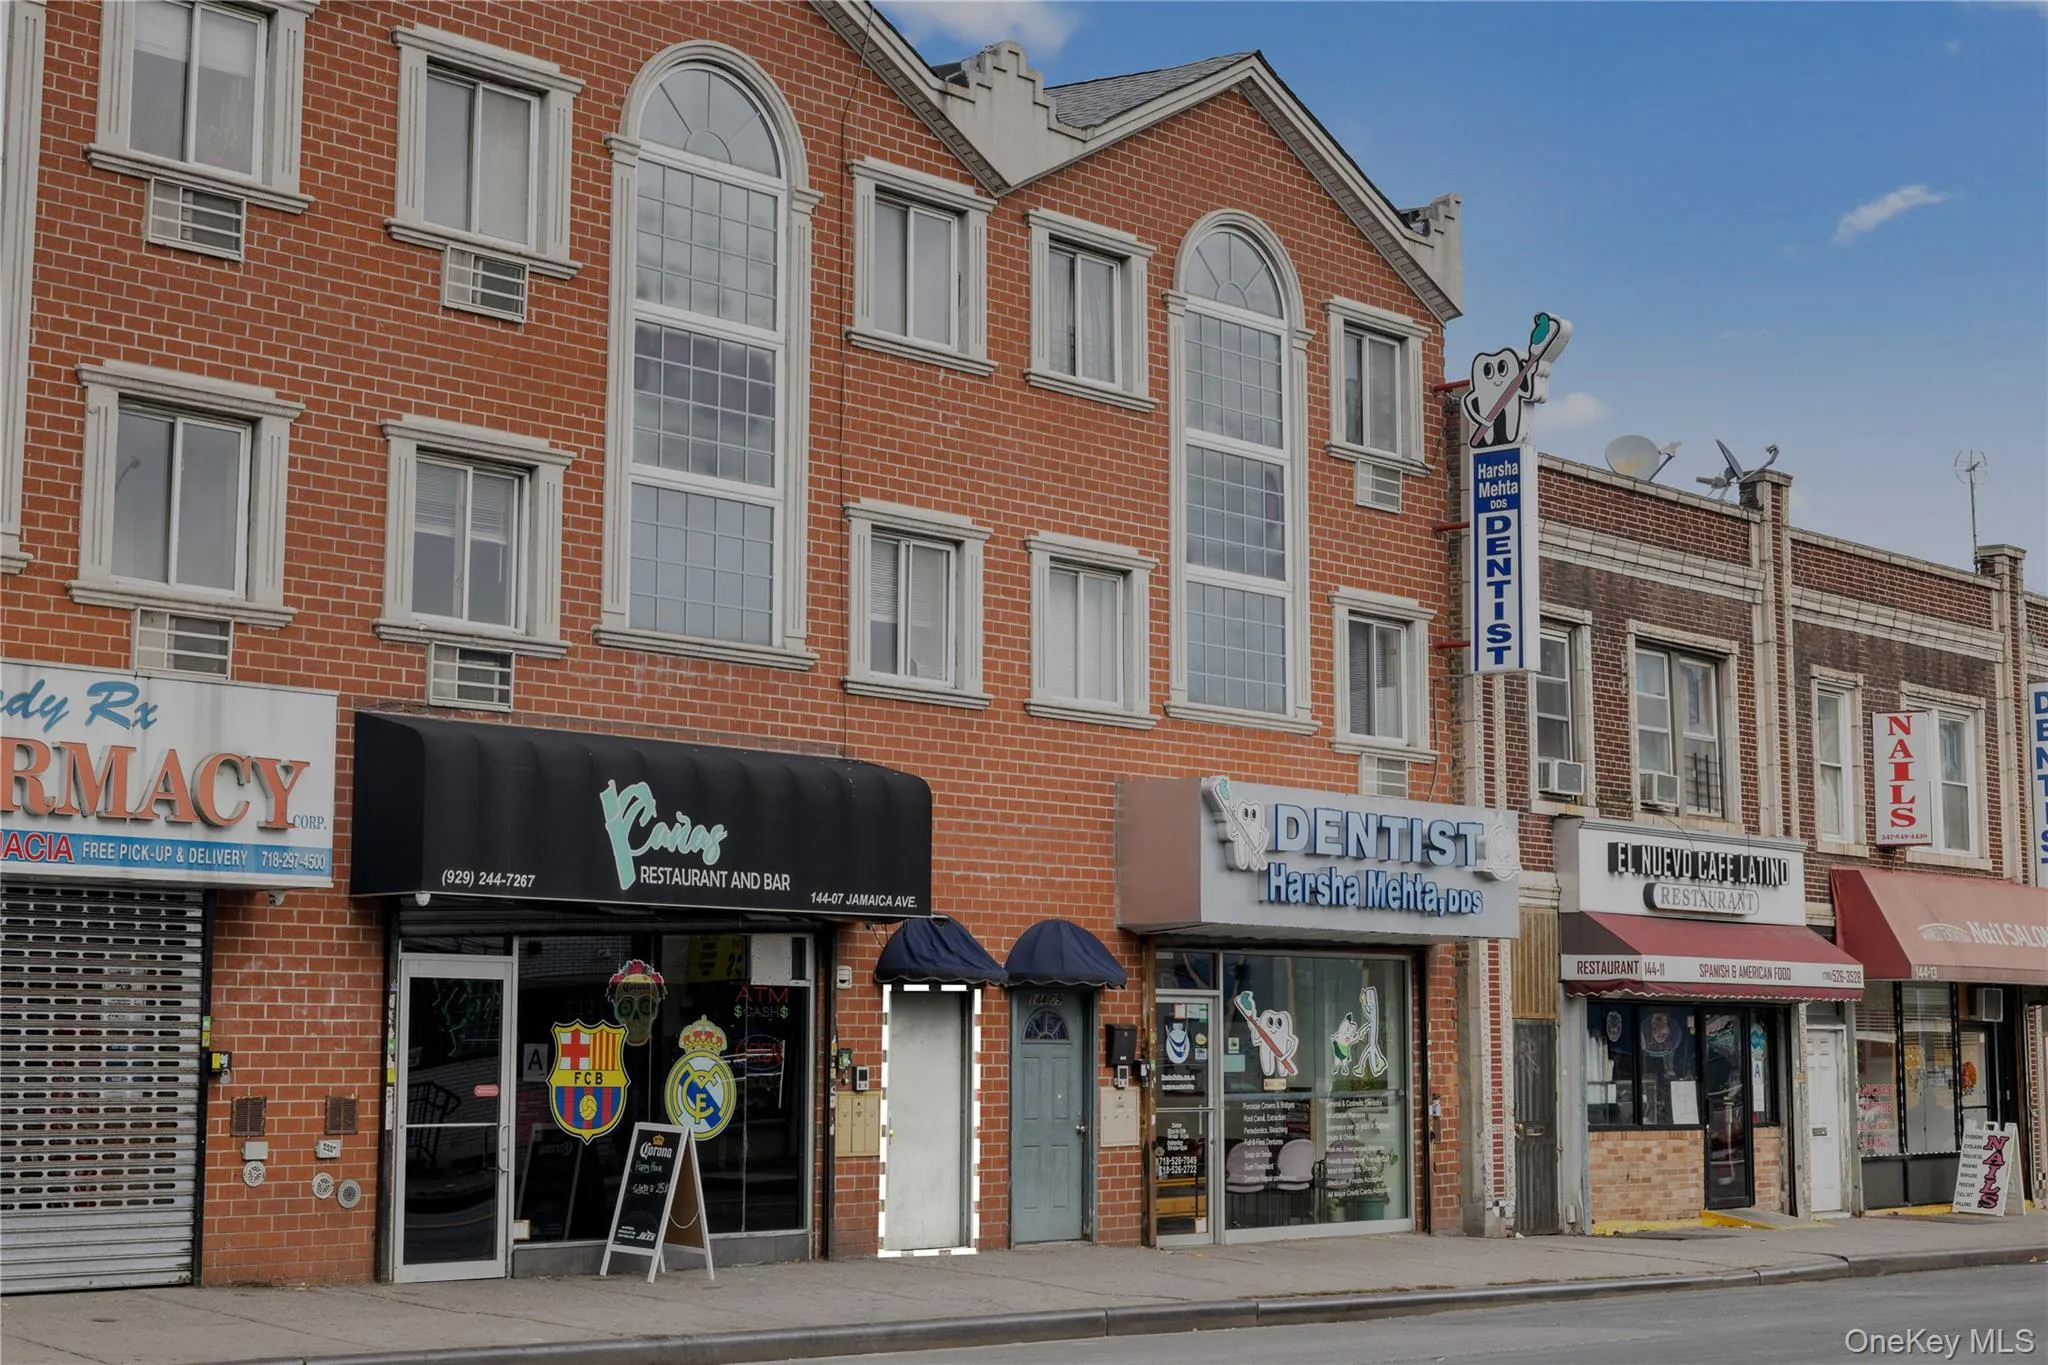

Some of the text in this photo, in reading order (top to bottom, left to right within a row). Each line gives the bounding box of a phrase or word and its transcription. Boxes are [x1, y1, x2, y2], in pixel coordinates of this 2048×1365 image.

[1478, 459, 1519, 479] Harsha
[1478, 481, 1519, 498] Mehta
[1490, 499, 1508, 509] DDS
[1486, 515, 1512, 665] DENTIST
[0, 679, 158, 733] dy Rx
[1887, 715, 1916, 827] NAILS
[293, 815, 327, 830] CORP.
[1274, 803, 1484, 867] DENTIST
[83, 841, 326, 871] FREE PICK-UP & DELIVERY 718-297-4500
[1617, 842, 1789, 886] EL NUEVO CAFE LATINO
[442, 869, 536, 888] (929) 244-7267
[640, 865, 791, 891] RESTAURANT AND BAR
[1268, 862, 1360, 907] Harsha
[1447, 887, 1484, 915] DDS
[811, 892, 917, 908] 144-07 JAMAICA AVE.
[1661, 886, 1755, 911] RESTAURANT
[1966, 921, 2009, 945] Nail
[1577, 960, 1639, 975] RESTAURANT
[1700, 963, 1792, 981] SPANISH & AMERICAN FOOD
[735, 984, 789, 1003] ATM
[528, 1049, 543, 1071] A
[574, 1072, 603, 1085] FCB
[1754, 1068, 1761, 1079] A
[640, 1142, 673, 1160] Corona
[1978, 1135, 2010, 1209] NAILS
